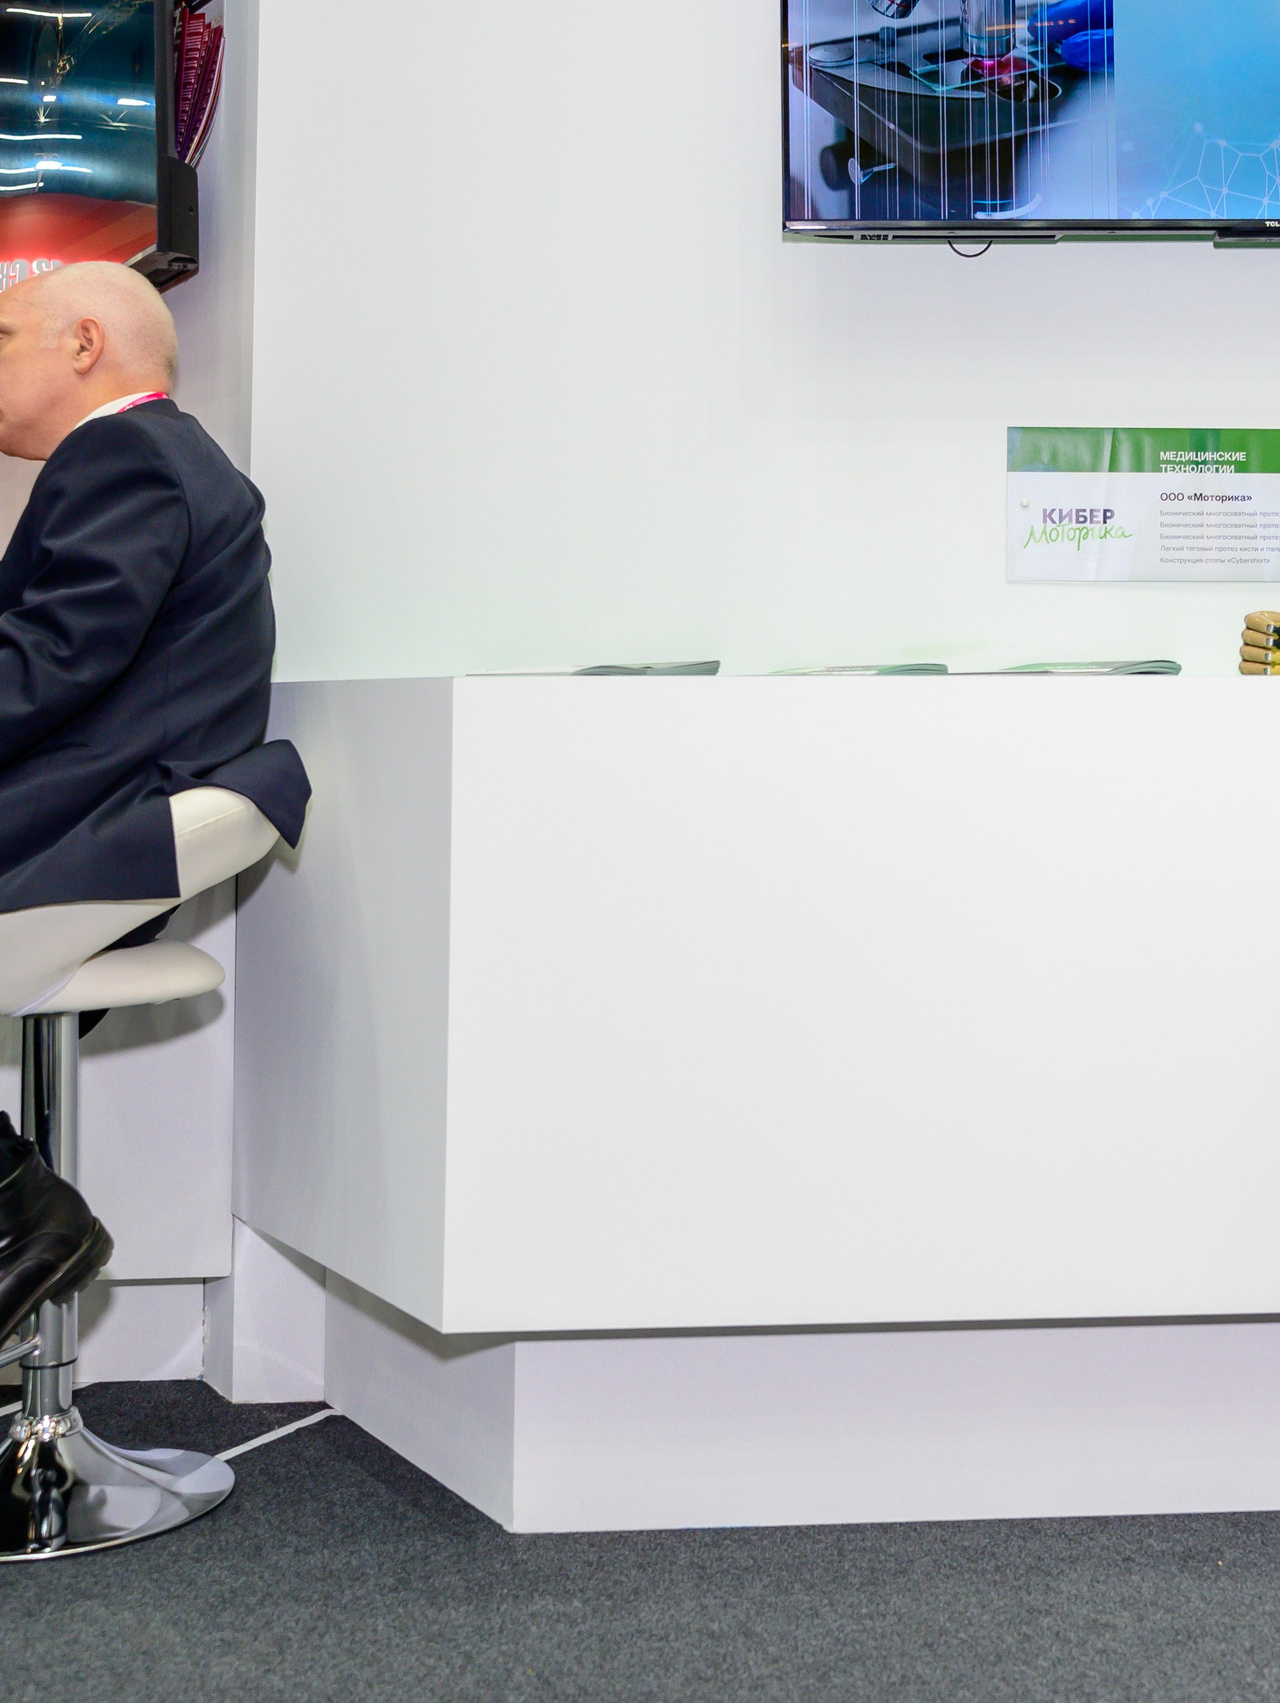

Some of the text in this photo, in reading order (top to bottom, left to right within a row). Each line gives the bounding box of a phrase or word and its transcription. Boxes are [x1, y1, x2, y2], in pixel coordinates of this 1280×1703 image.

[1264, 220, 1280, 228] TCL
[1159, 451, 1247, 462] МЕДИЦИНСКИЕ
[1159, 464, 1235, 474] ТЕХНОЛОГИИ
[1160, 492, 1253, 504] ООО «Моторика»
[1042, 508, 1116, 525] КИБЕР
[1159, 509, 1205, 517] Бионический
[1159, 521, 1205, 529] Бионический
[1023, 521, 1133, 551] Моторика
[1159, 544, 1185, 552] Легкий
[1159, 556, 1204, 564] Конструкция
[1226, 556, 1271, 565] «Cybershort»
